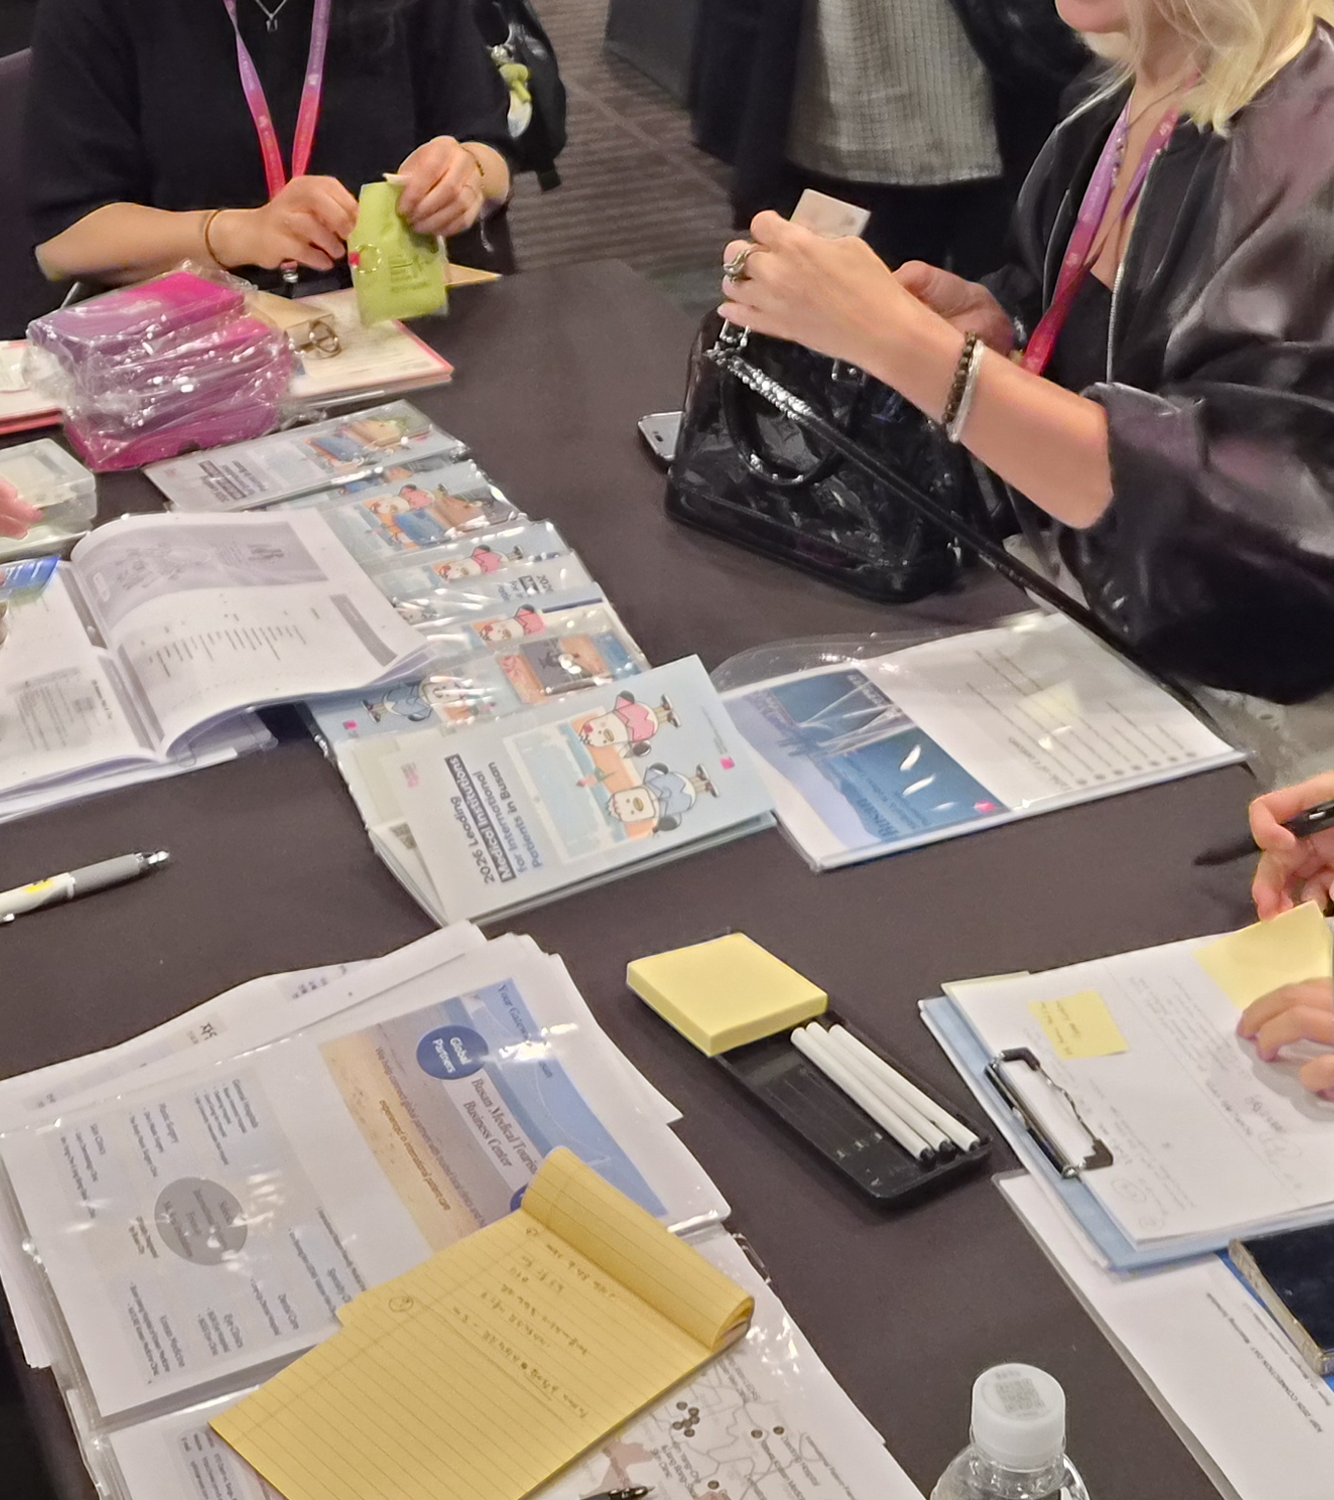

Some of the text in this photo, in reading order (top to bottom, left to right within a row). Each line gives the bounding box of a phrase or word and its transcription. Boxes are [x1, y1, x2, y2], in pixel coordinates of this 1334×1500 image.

[445, 755, 515, 879] Medical Institutions
[446, 794, 496, 884] 2026 Leading
[470, 769, 529, 873] for International
[484, 761, 545, 868] Patients in Busan
[494, 984, 517, 1006] Your
[505, 1007, 537, 1042] Gatewa
[428, 1037, 461, 1073] Partners
[446, 1036, 474, 1065] Global
[462, 1100, 514, 1167] Business Center
[469, 1078, 498, 1107] Busan
[487, 1106, 521, 1142] Medical
[402, 1140, 431, 1177] international
[422, 1176, 443, 1199] patient
[438, 1198, 451, 1210] care
